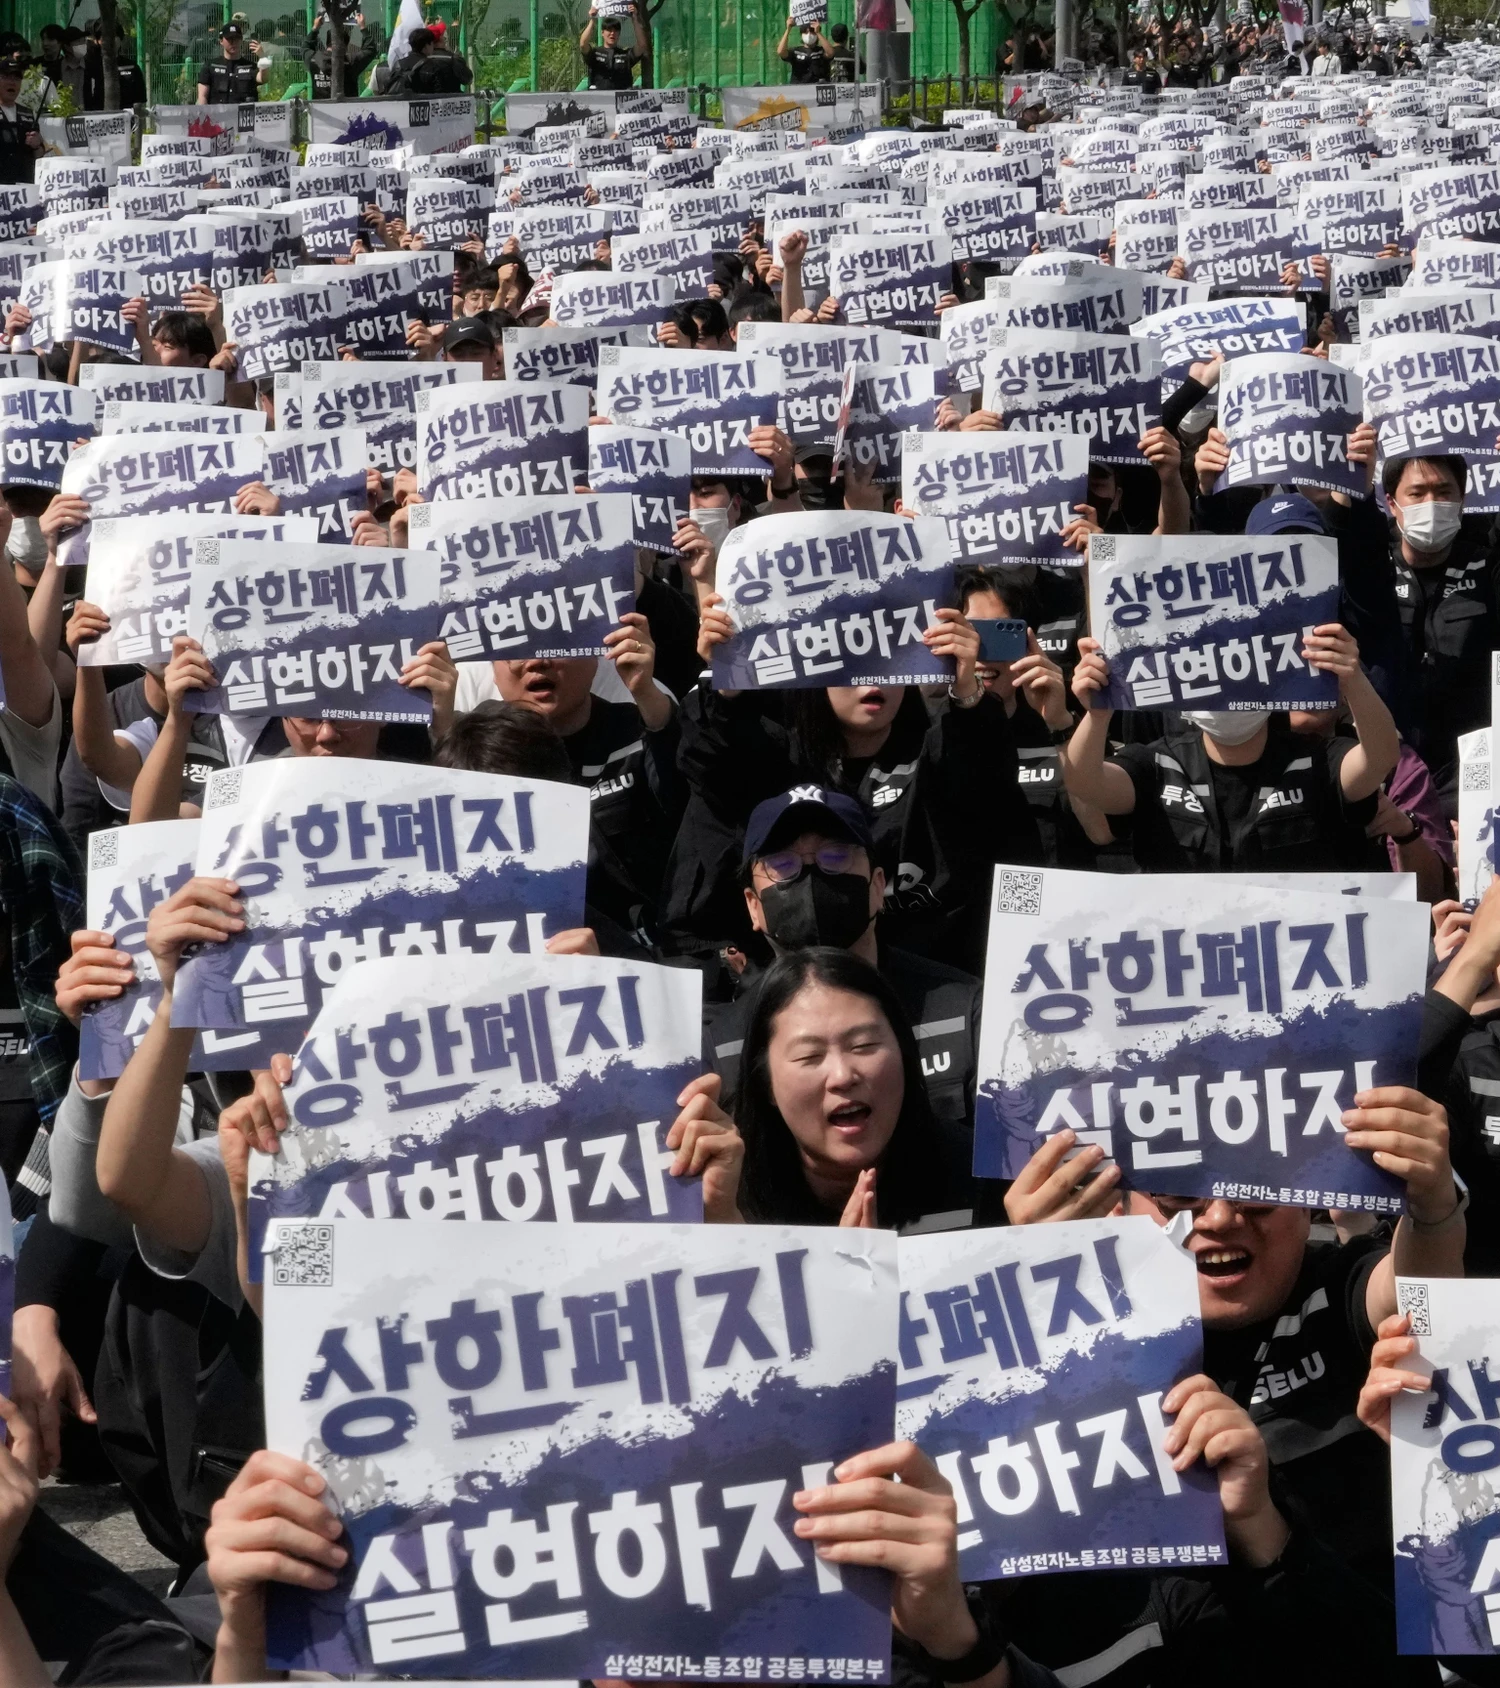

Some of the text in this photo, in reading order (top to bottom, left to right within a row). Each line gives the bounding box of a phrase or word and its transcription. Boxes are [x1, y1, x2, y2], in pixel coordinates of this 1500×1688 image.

[618, 112, 661, 136] 상한폐지
[1315, 130, 1367, 154] 상한폐지
[578, 141, 628, 165] 상한폐지
[1004, 133, 1052, 156] 상한폐지
[1422, 133, 1479, 155] 상한폐지
[44, 166, 107, 191] 상한폐지
[520, 171, 580, 197] 상한폐지
[647, 156, 704, 181] 상한폐지
[412, 189, 482, 214] 상한폐지
[668, 192, 738, 222] 상한폐지
[1068, 177, 1132, 203] 상한폐지
[1189, 178, 1265, 209] 상한폐지
[1303, 188, 1385, 220] 상한폐지
[1409, 170, 1499, 214] 상한폐지
[518, 214, 592, 242] 상한폐지
[942, 192, 1022, 228] 상한폐지
[95, 226, 198, 262] 상한폐지
[418, 218, 488, 244] 실현하자
[1184, 213, 1278, 252] 상한폐지
[618, 236, 699, 272] 상한폐지
[836, 239, 936, 282] 상한폐지
[1194, 251, 1291, 288] 실현하자
[230, 290, 331, 336] 상한폐지
[556, 273, 660, 322] 상한폐지
[843, 282, 950, 321] 실현하자
[1146, 301, 1274, 340] 상한폐지
[241, 334, 345, 376] 실현하자
[1162, 328, 1301, 366] 실현하자
[610, 360, 755, 414] 상한폐지
[999, 344, 1142, 396] 상한폐지
[1364, 345, 1499, 402] 상한폐지
[1223, 369, 1348, 428] 상한폐지
[424, 389, 563, 463] 상한폐지
[914, 438, 1065, 502] 상한폐지
[1229, 430, 1357, 485] 실현하자
[425, 499, 604, 585] 상한폐지
[730, 524, 923, 606] 상한폐지
[206, 556, 407, 631] 상한폐지
[1104, 544, 1306, 628] 상한폐지
[438, 576, 635, 661] 실현하자
[747, 599, 940, 685] 실현하자
[221, 638, 419, 711] 실현하자
[1126, 626, 1320, 708] 실현하자
[321, 708, 431, 723] 삼성전자노동조합 공동투쟁본부
[1228, 701, 1289, 710] 삼성전자노동조합
[589, 772, 635, 800] SELU
[214, 791, 536, 898] 상한폐지
[1011, 912, 1369, 1034] 상한폐지
[292, 976, 644, 1129] 상한폐지
[1211, 1181, 1402, 1214] 삼성전자노동조합 공동투쟁본부
[301, 1249, 814, 1457] 상한폐지
[1253, 1350, 1326, 1401] SELU
[352, 1463, 848, 1664] 실현하자
[1000, 1543, 1223, 1574] 삼성전자노동조합 공동투쟁본부
[605, 1654, 885, 1680] 삼성전자노동조합 공동투쟁본부
